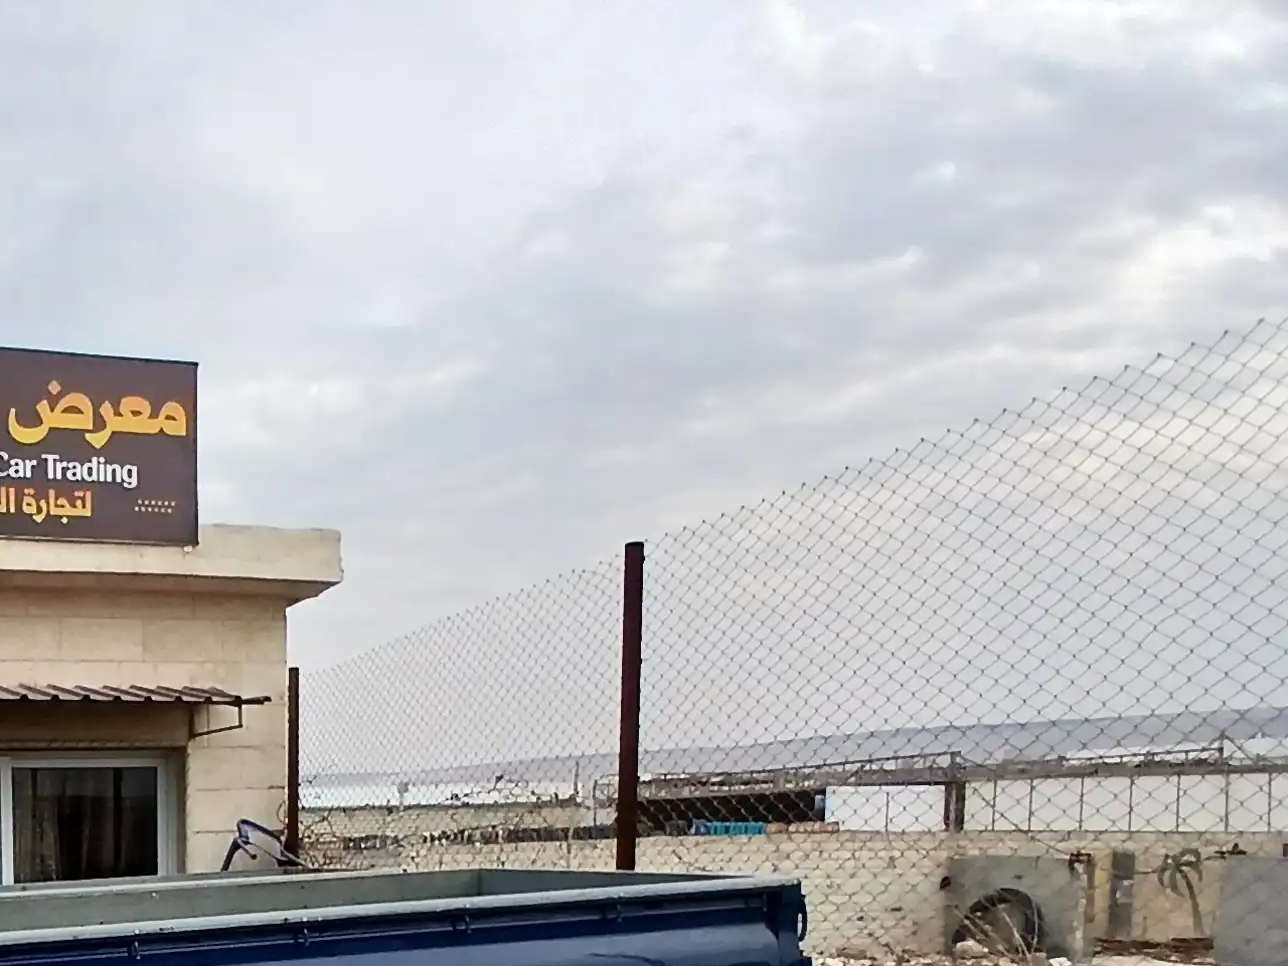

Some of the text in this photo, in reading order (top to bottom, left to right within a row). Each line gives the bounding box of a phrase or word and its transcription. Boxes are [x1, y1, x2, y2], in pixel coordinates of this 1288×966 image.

[8, 380, 187, 449] معرض
[41, 454, 138, 489] Trading
[22, 488, 92, 524] لتجارة
